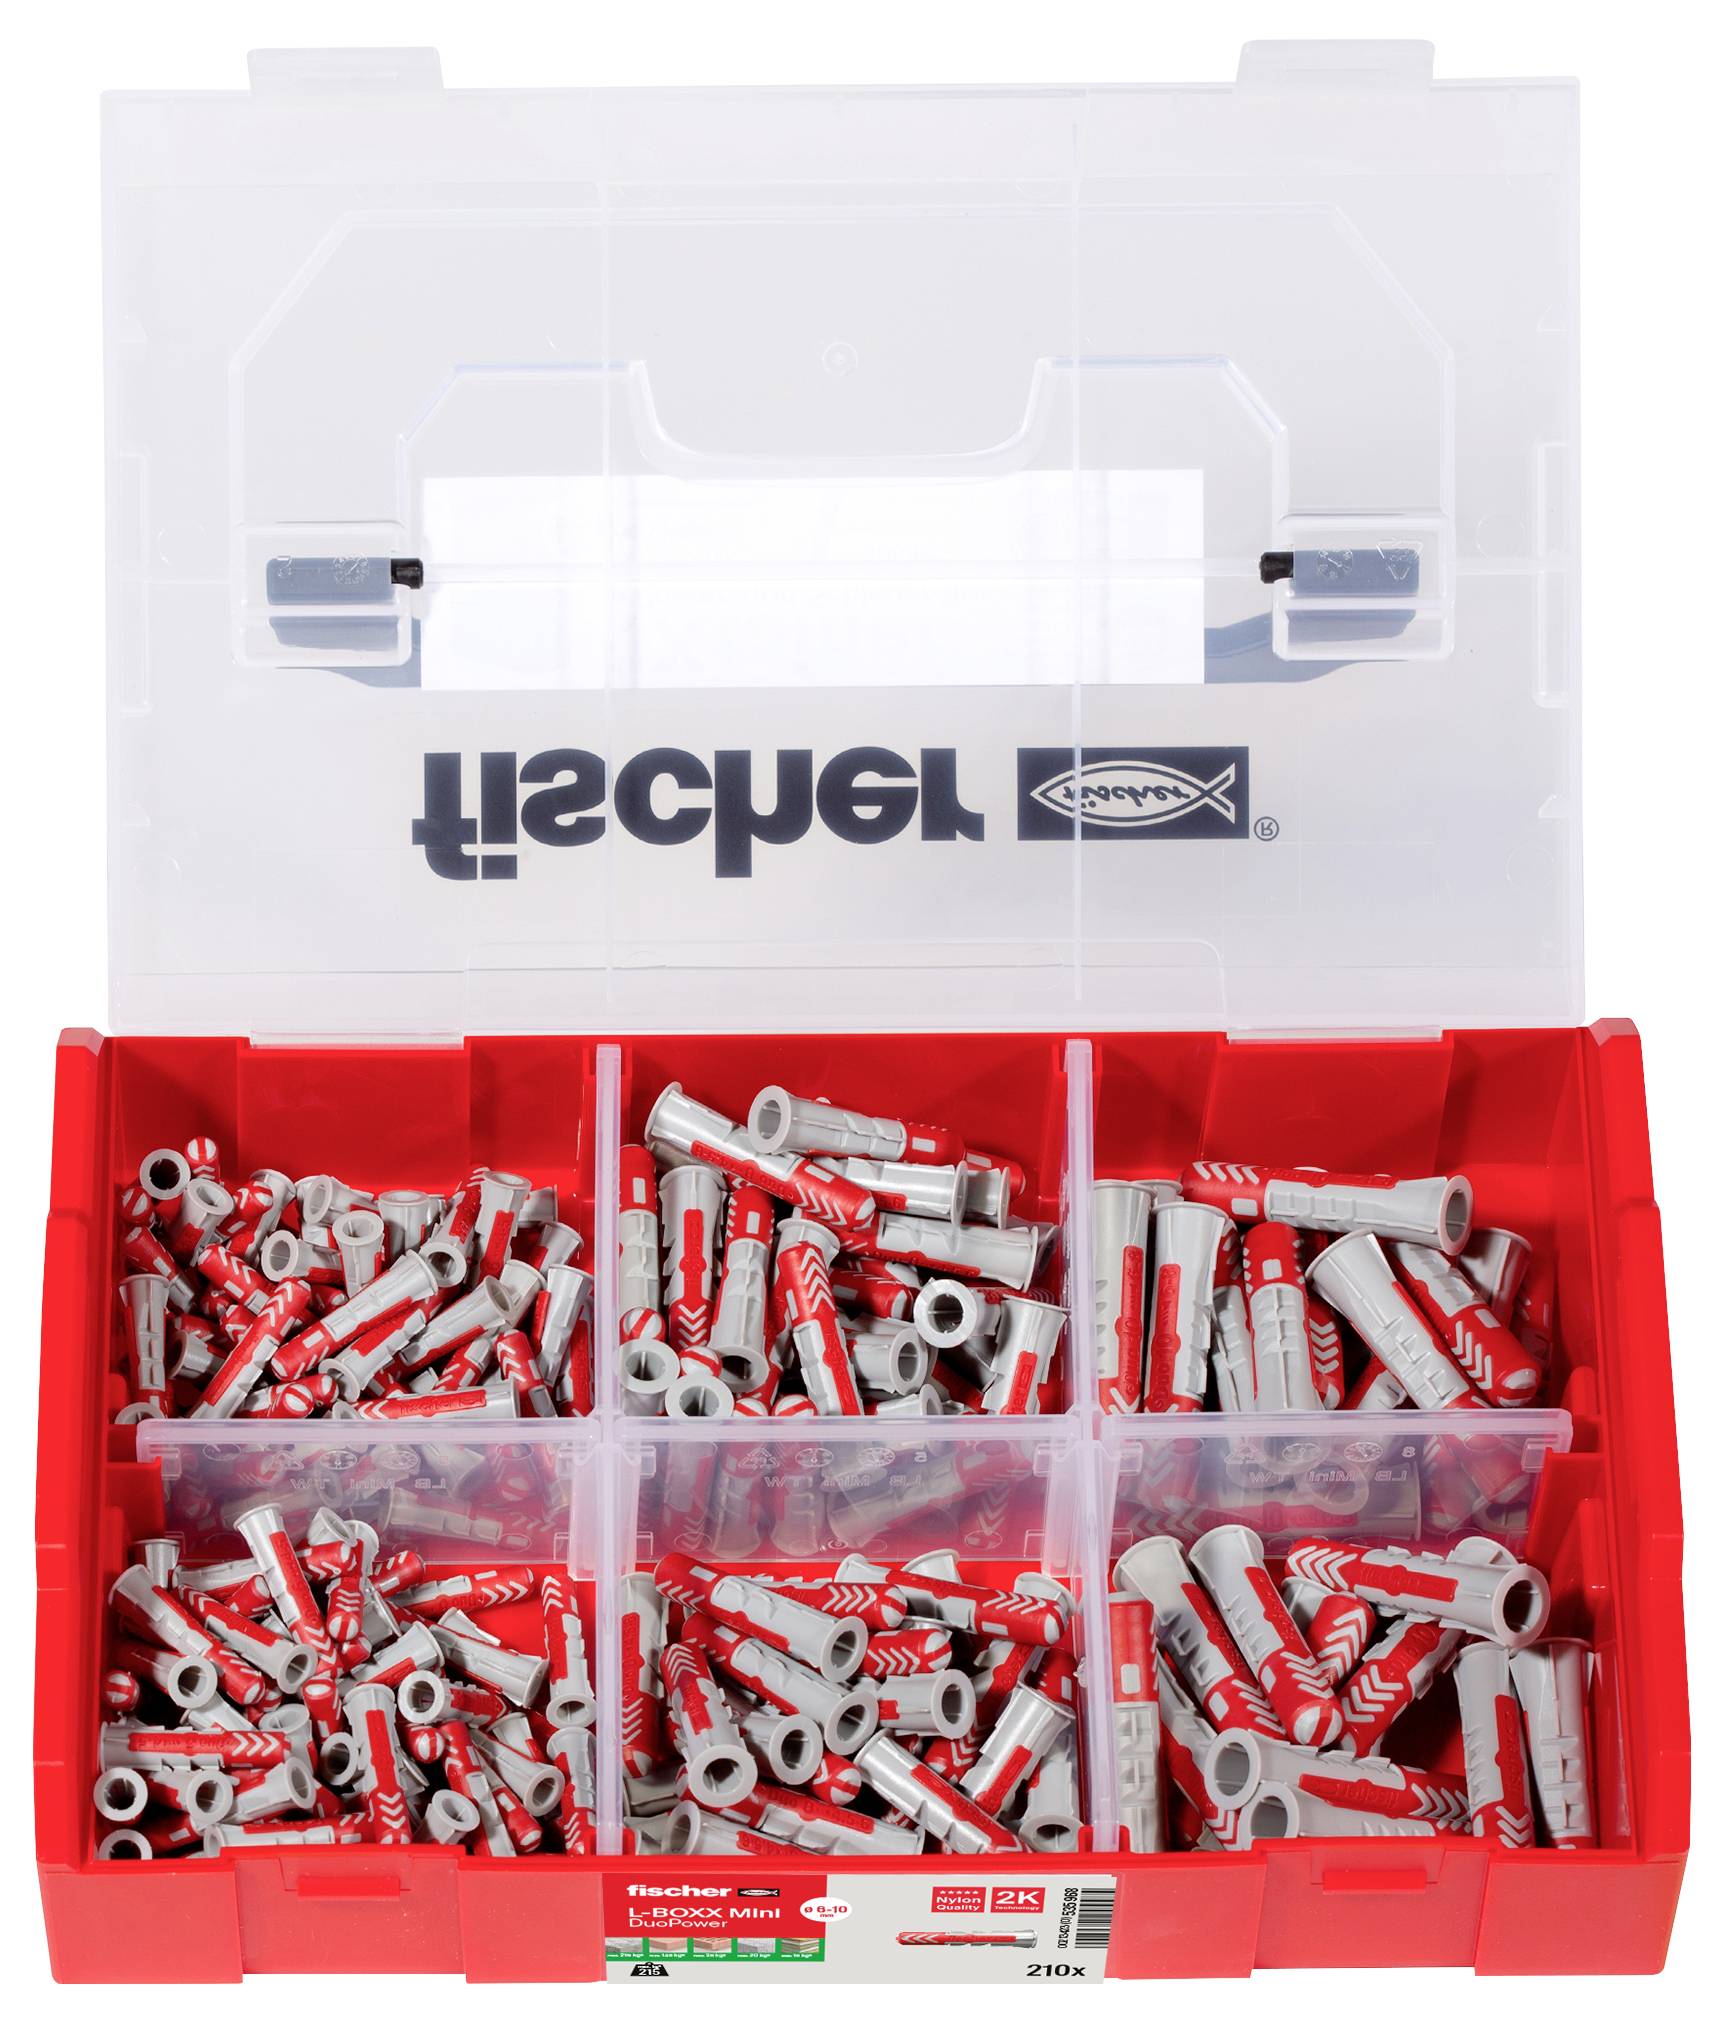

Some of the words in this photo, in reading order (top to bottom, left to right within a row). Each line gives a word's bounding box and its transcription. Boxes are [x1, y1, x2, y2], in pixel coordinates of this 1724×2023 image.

[626, 1884, 732, 1897] fischer
[936, 1896, 981, 1904] Nylon
[995, 1891, 1040, 1905] 2K
[629, 1907, 724, 1919] L-BOXX
[816, 1905, 848, 1914] 6-10
[629, 1918, 728, 1928] DuoPower
[638, 1968, 660, 1976] 215
[1026, 1964, 1086, 1977] 210x
